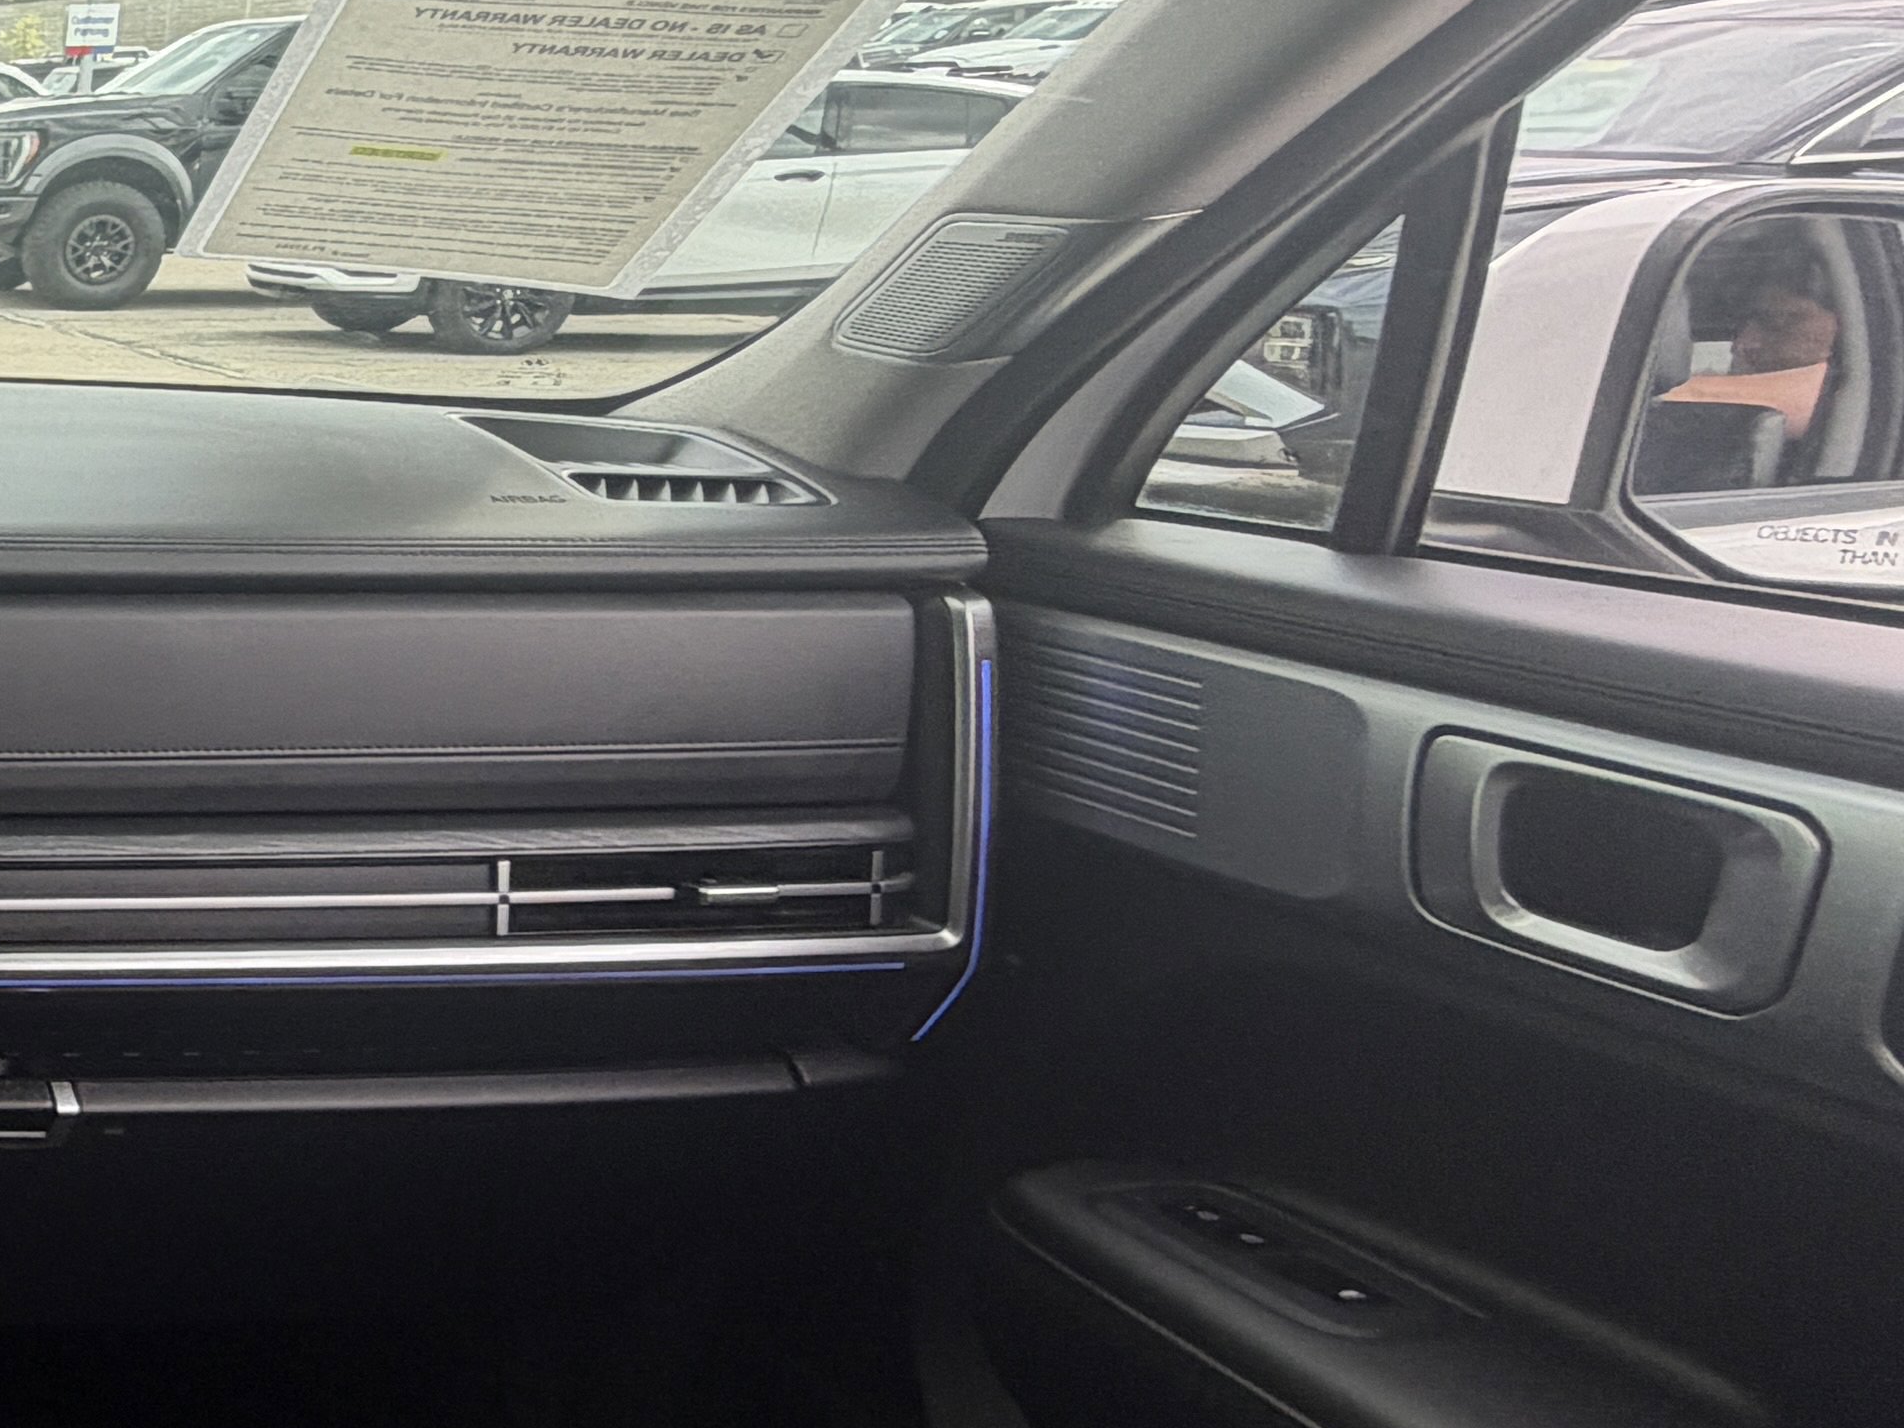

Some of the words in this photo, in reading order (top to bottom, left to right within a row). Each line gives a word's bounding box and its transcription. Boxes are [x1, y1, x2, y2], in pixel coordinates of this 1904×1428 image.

[490, 495, 567, 504] AIRBAG
[1757, 525, 1859, 545] OBJECTS
[1838, 549, 1899, 566] THAN
